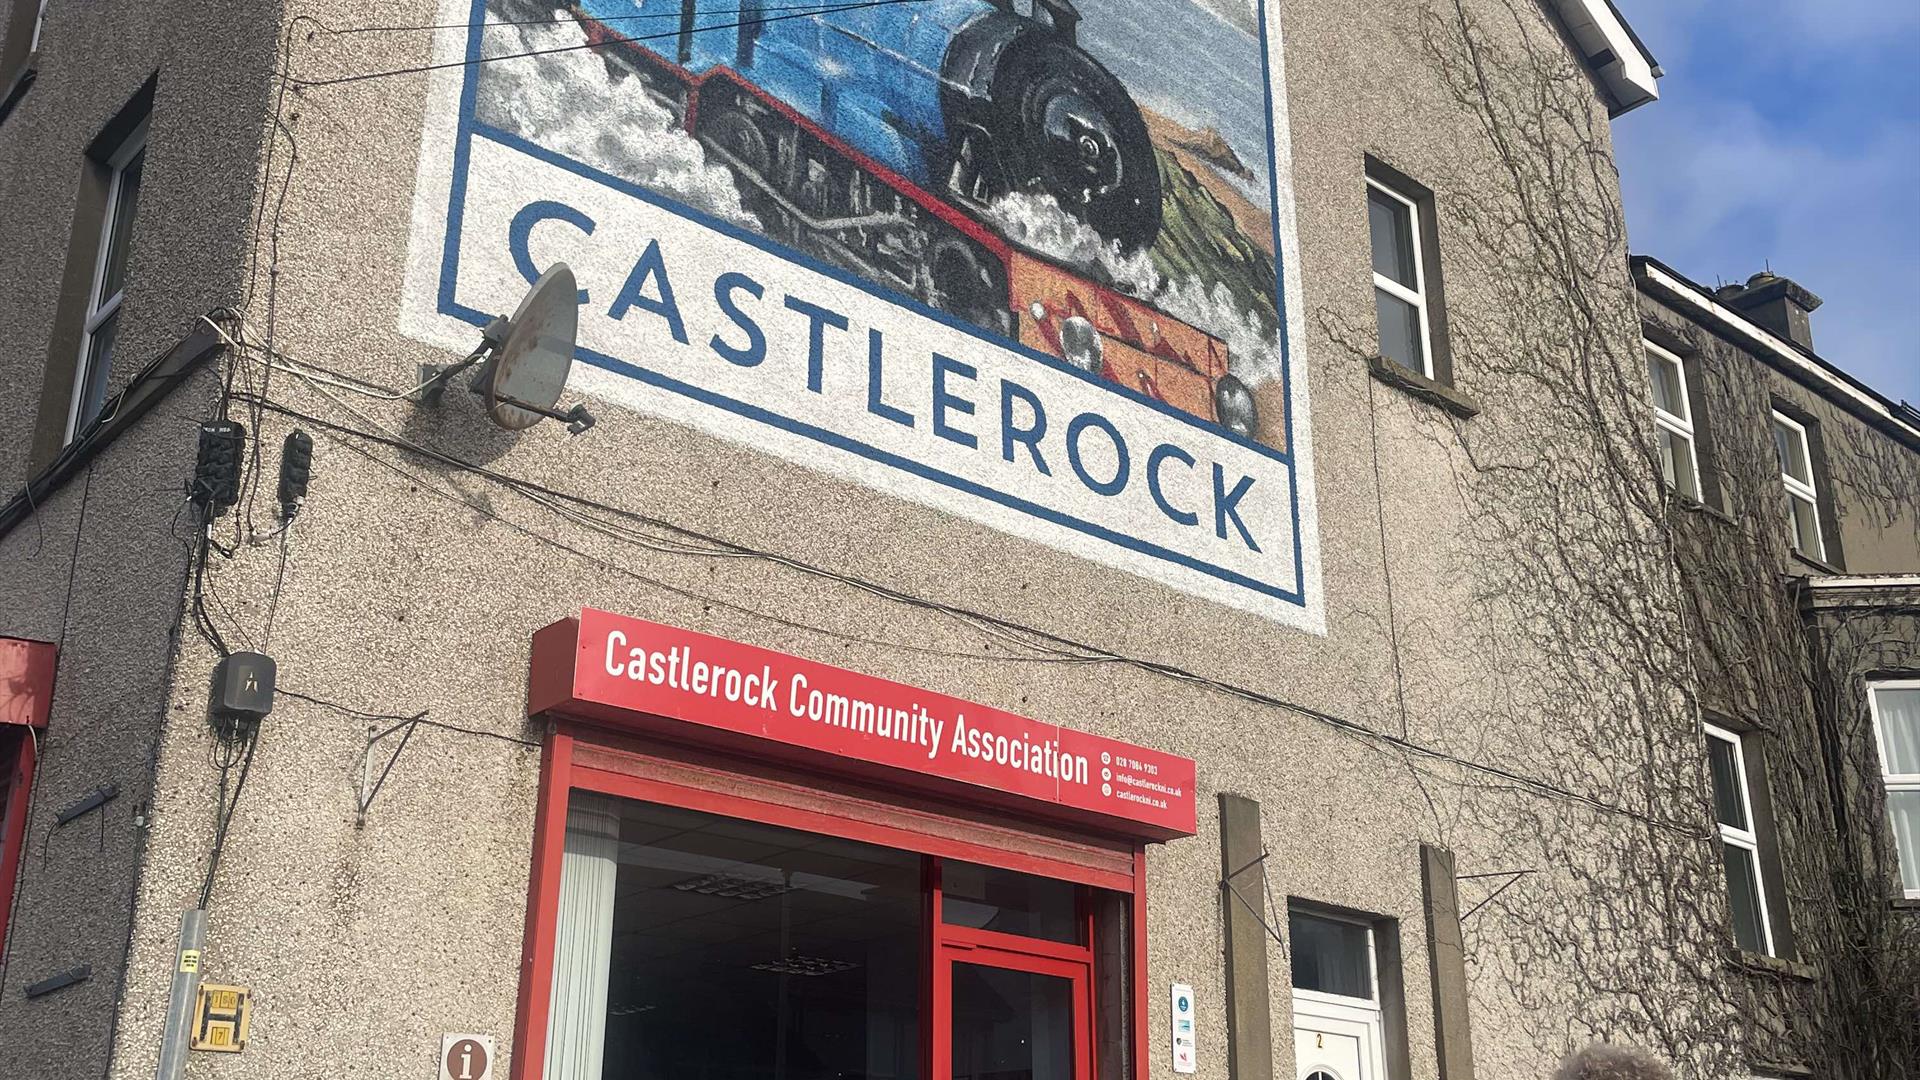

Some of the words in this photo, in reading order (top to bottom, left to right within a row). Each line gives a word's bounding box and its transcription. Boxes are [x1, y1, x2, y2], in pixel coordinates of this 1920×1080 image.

[509, 199, 1262, 554] CASTLEROCK
[605, 630, 778, 712] Castlerock
[789, 673, 944, 759] Community
[951, 714, 1089, 785] Association
[1116, 773, 1182, 797] info@castlerockni.co.uk
[1116, 790, 1167, 808] castlerockni.co.uk
[1316, 1033, 1323, 1049] 2
